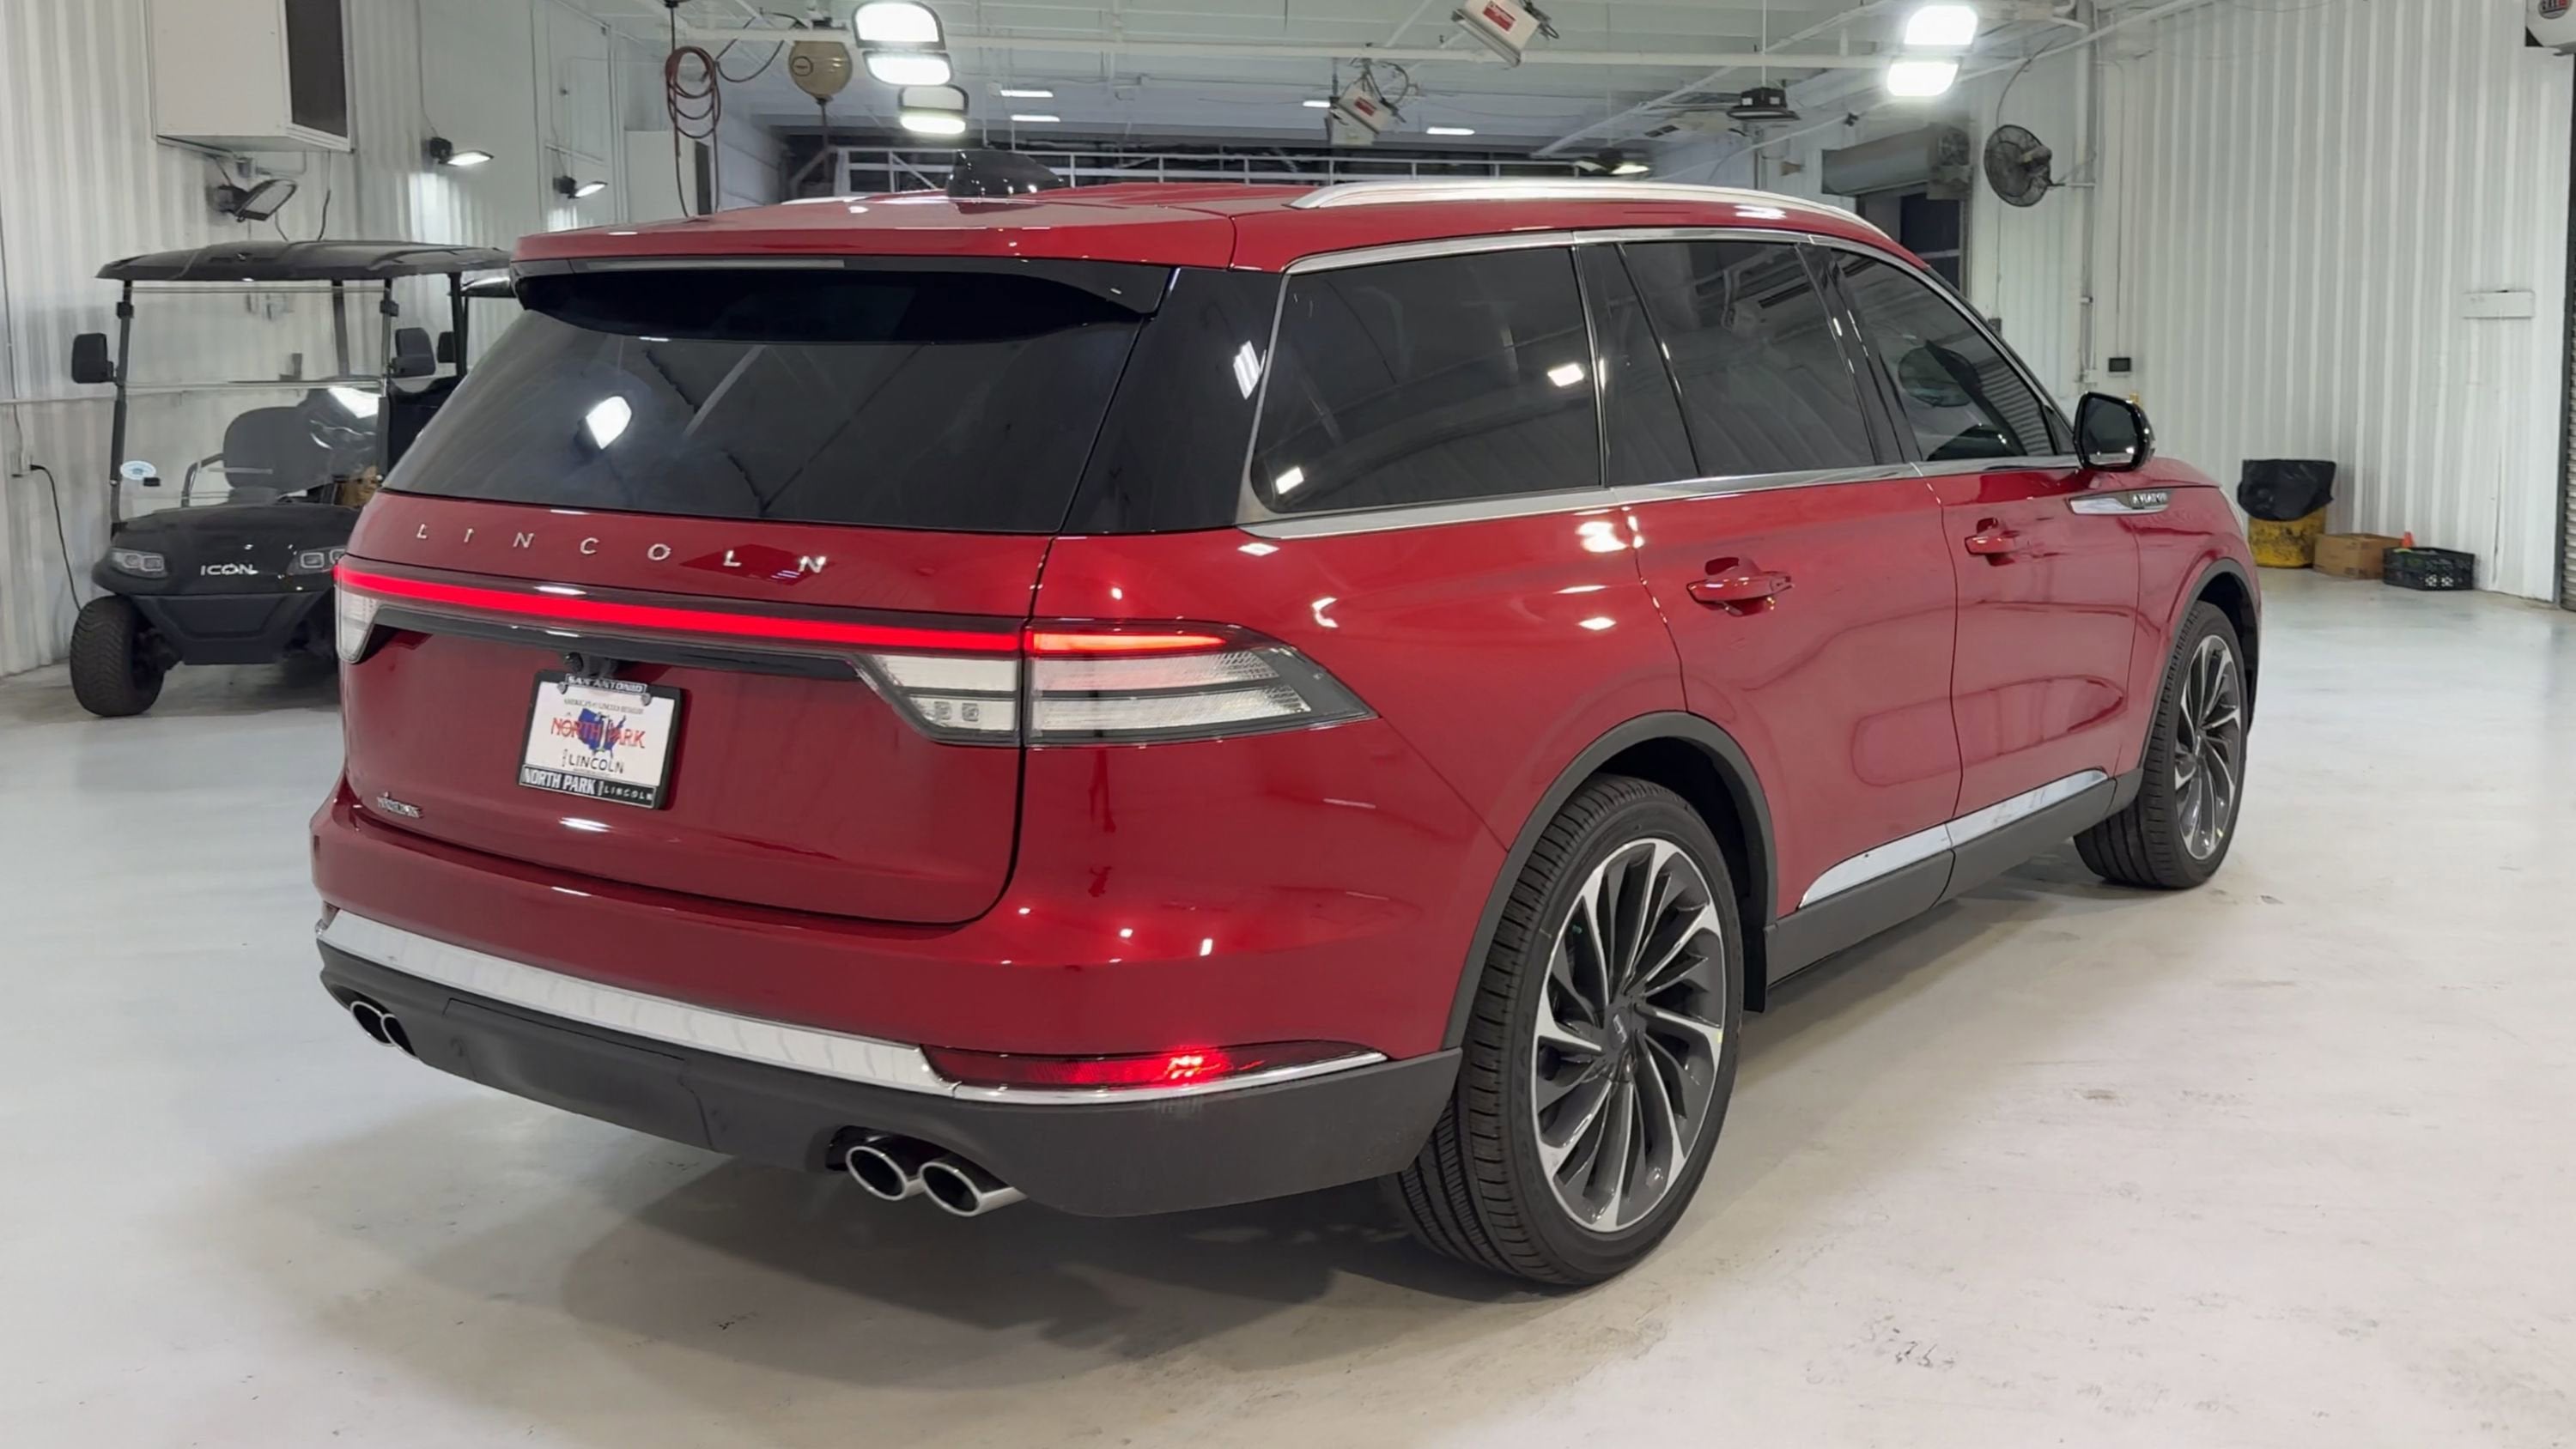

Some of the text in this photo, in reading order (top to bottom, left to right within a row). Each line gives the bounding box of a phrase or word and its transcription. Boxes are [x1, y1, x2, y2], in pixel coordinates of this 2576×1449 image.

[416, 523, 828, 573] LINCOLN
[200, 563, 258, 576] ICON
[568, 676, 643, 692] SAN ANTONIO
[551, 718, 646, 749] NORTH PARK
[568, 754, 624, 774] LINCOLN
[523, 767, 562, 788] NORTH
[562, 774, 596, 795] PARK
[604, 786, 653, 801] LINCOLN
